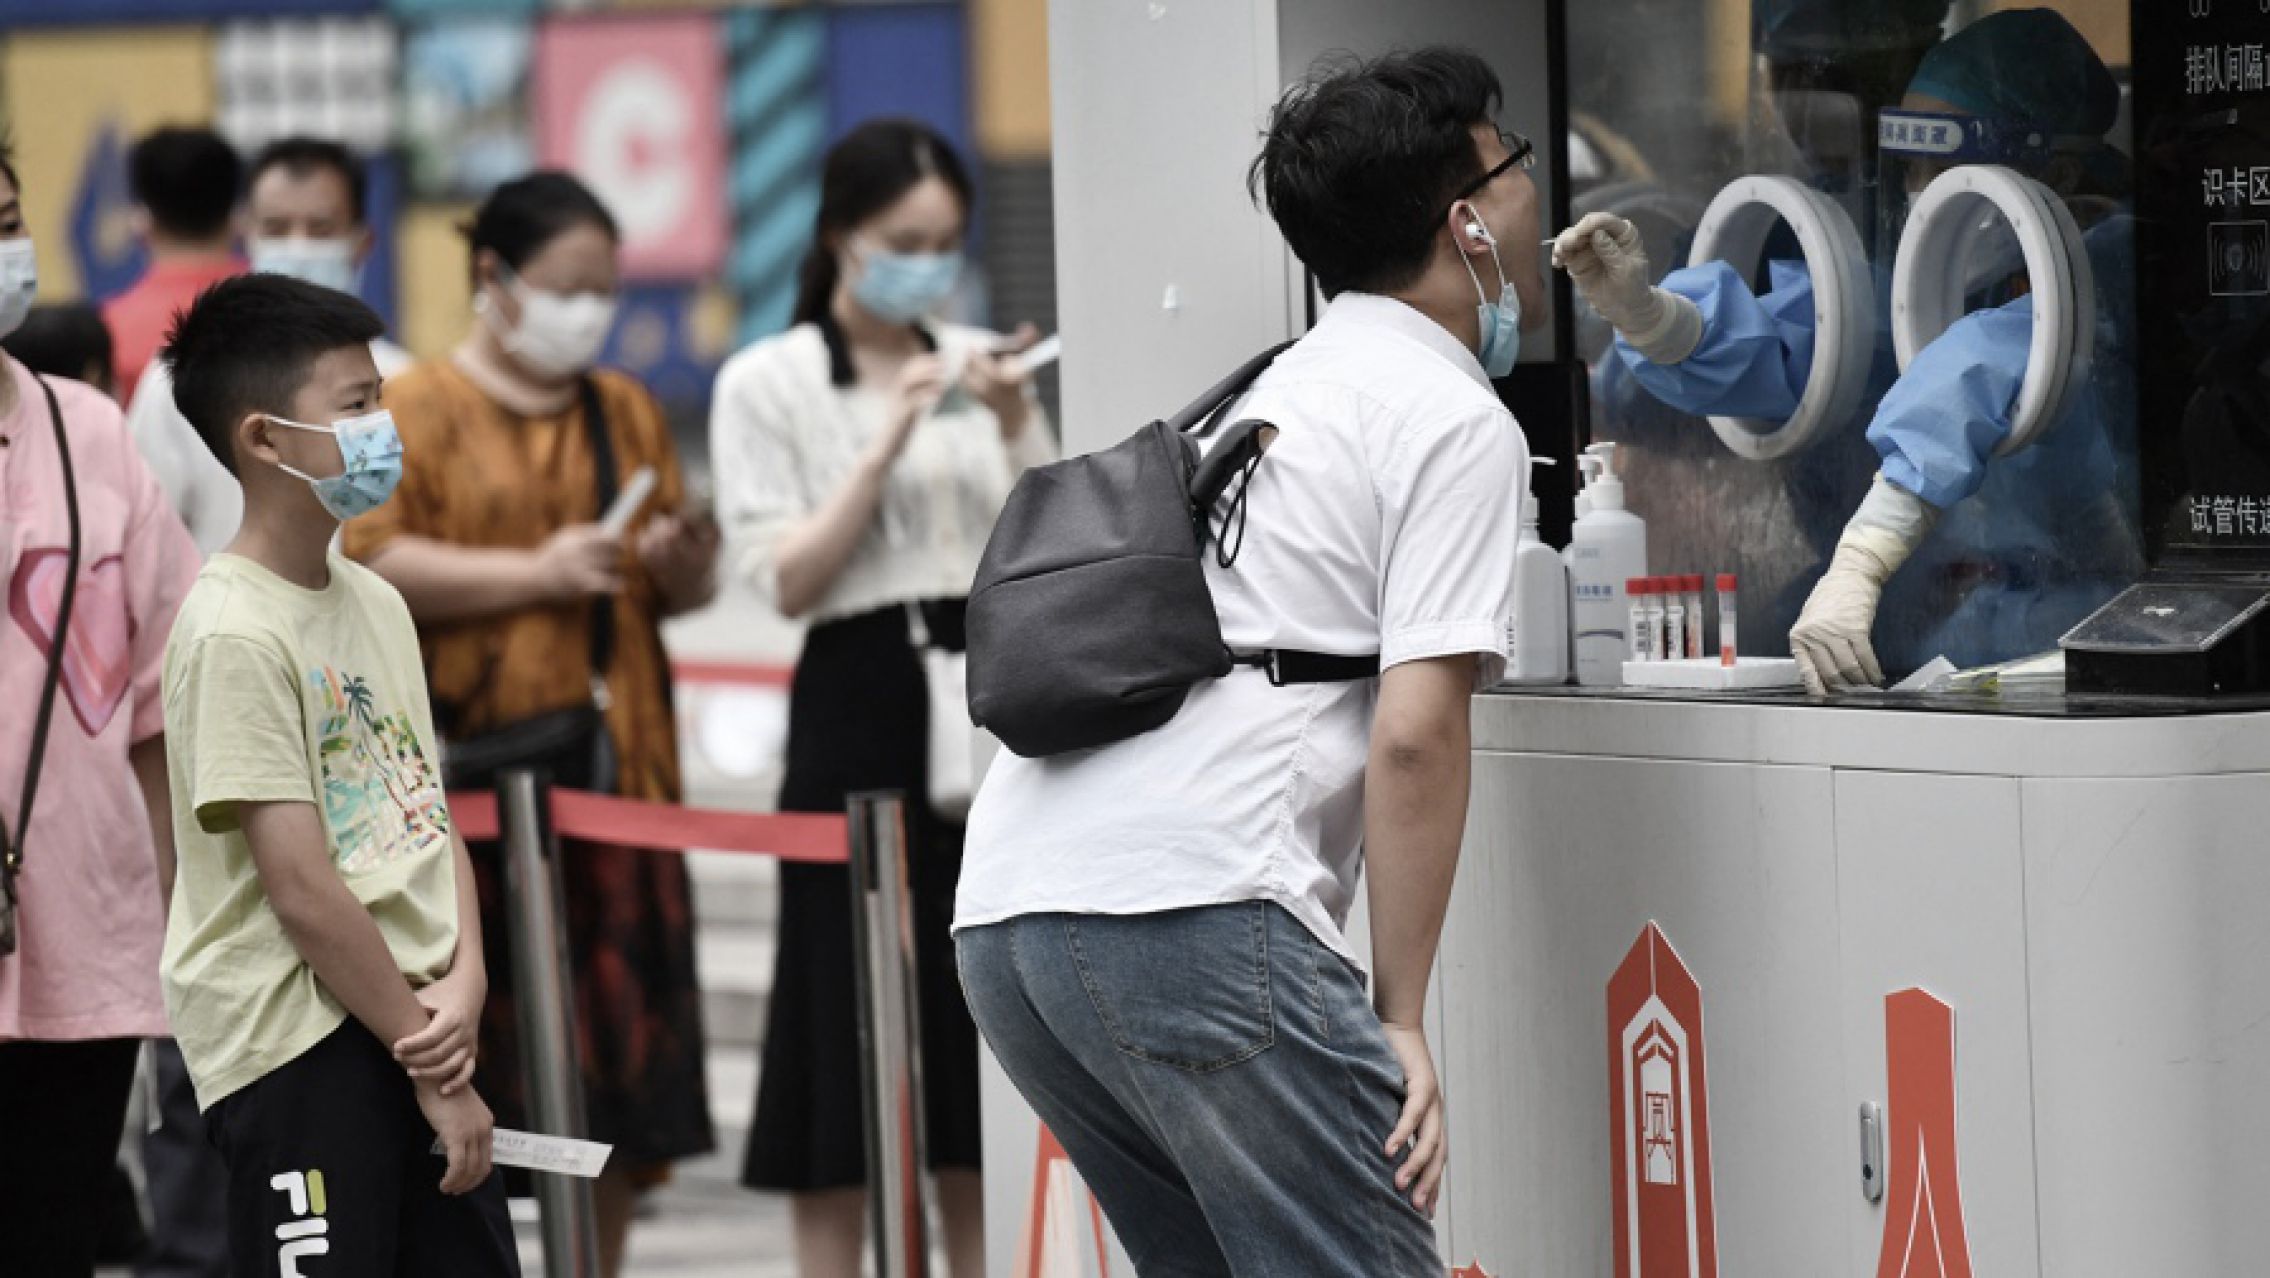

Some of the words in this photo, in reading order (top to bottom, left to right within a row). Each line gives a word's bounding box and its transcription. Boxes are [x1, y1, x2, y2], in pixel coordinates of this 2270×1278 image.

[575, 58, 692, 248] C
[2202, 165, 2270, 207] 识卡区
[270, 1169, 329, 1278] FIL
